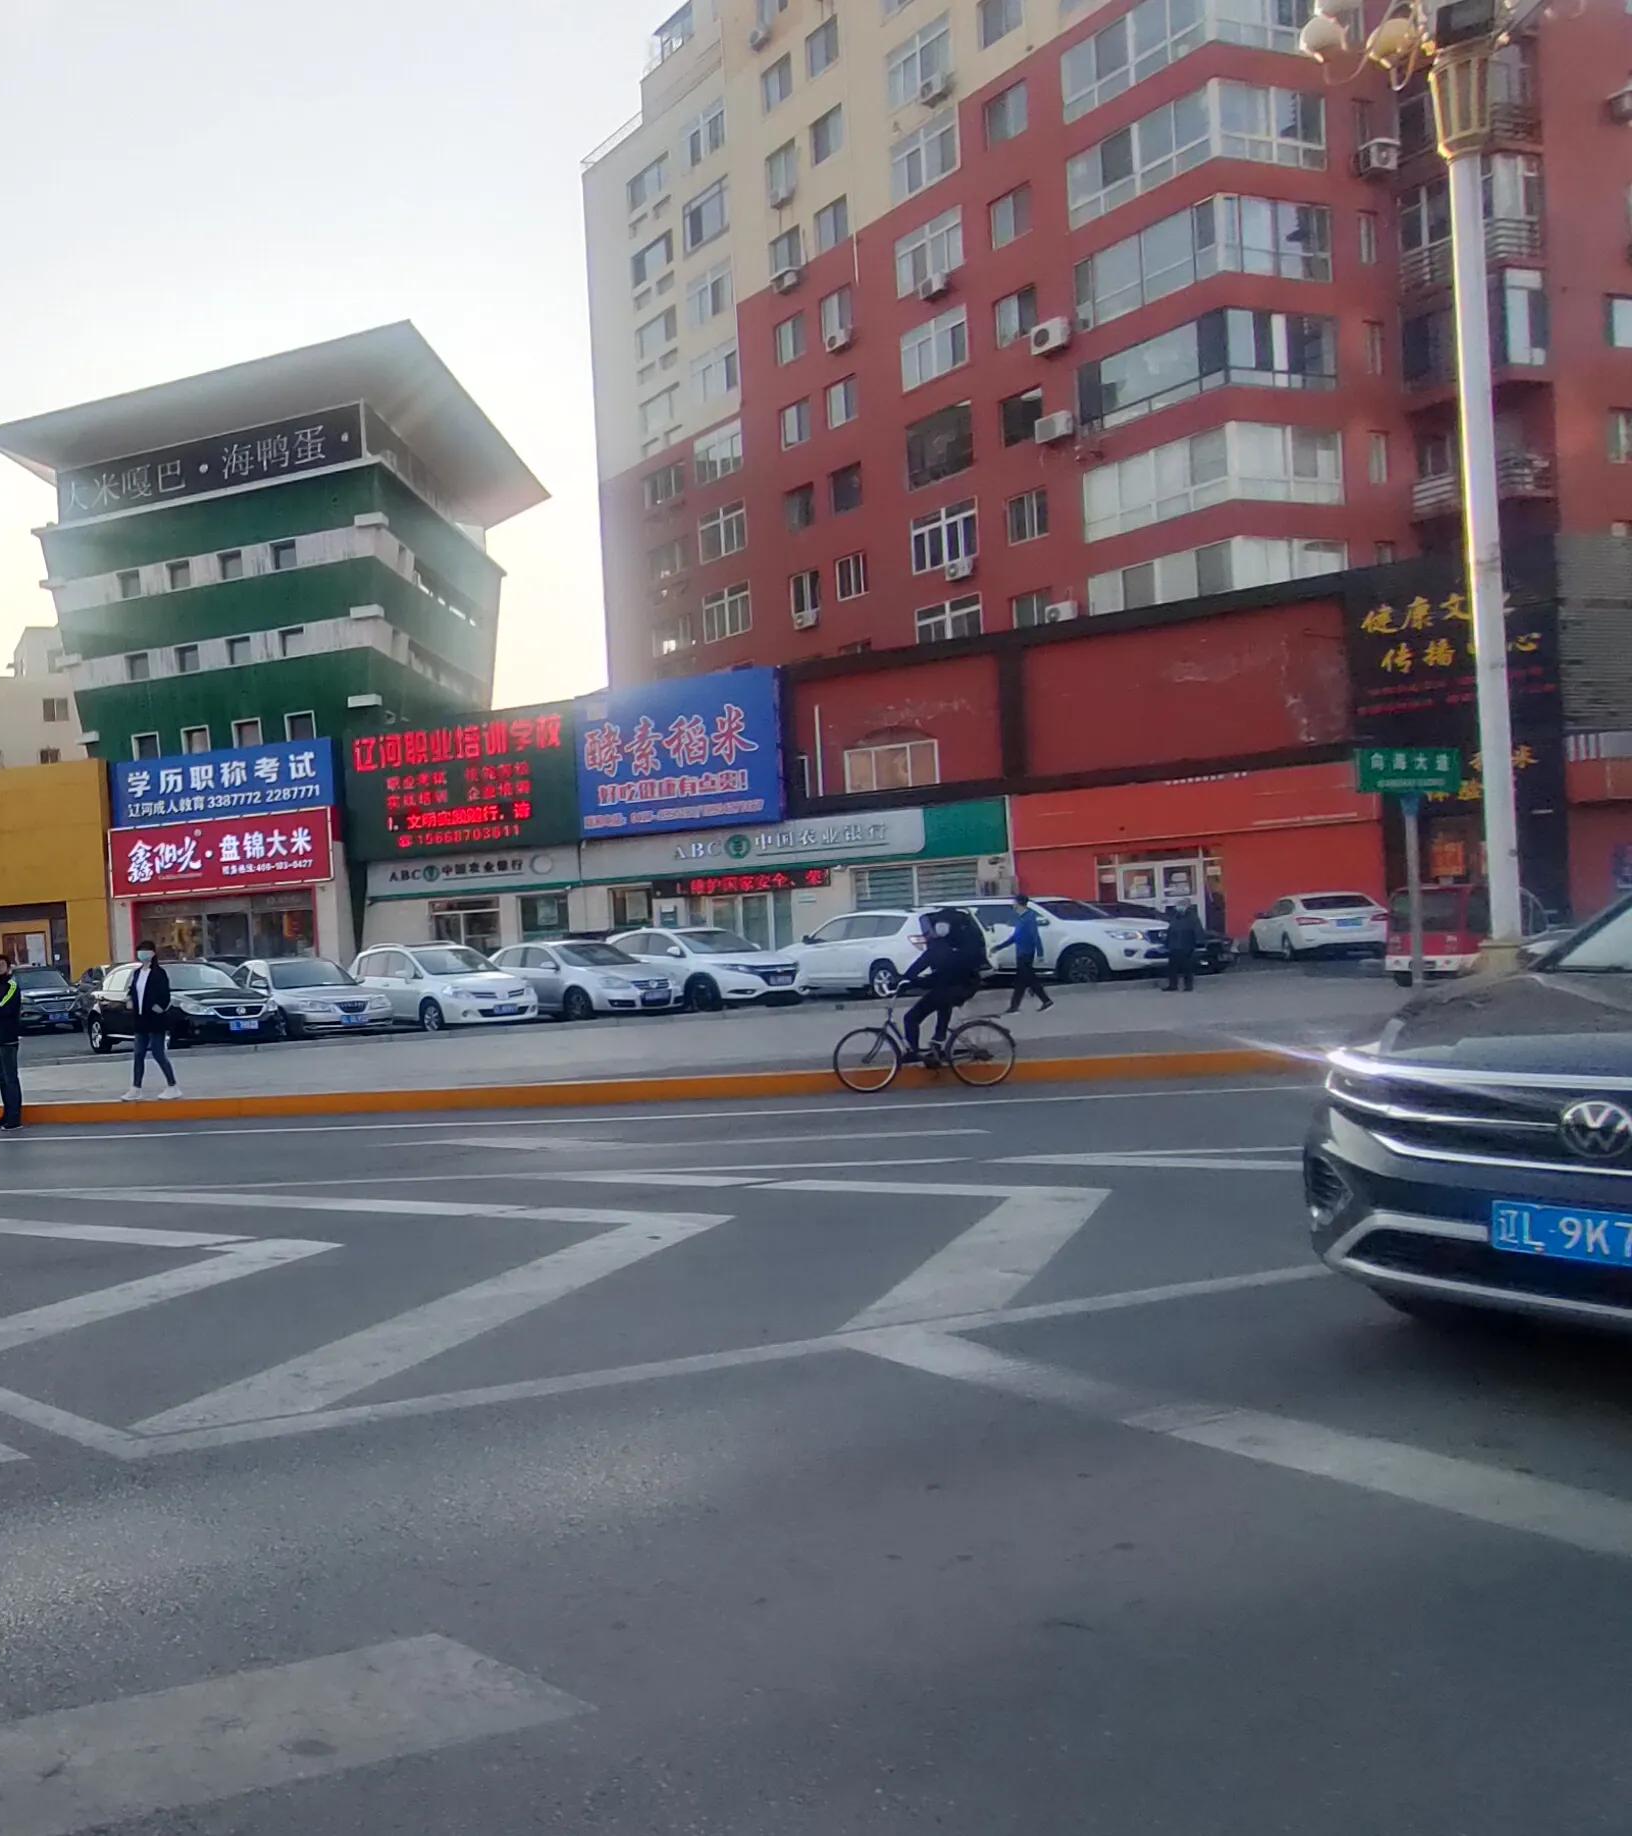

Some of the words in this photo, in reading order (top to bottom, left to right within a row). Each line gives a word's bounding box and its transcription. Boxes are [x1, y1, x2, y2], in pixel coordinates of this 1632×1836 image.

[1380, 633, 1542, 673] 传播心
[353, 714, 562, 773] 辽河职业培训学校
[584, 703, 759, 777] 酵素稻米
[127, 751, 317, 798] 学历职称考试
[207, 791, 261, 809] 3387772
[266, 784, 320, 802] 2287771
[219, 827, 312, 862] 盘锦大米
[674, 841, 721, 861] ABC
[754, 822, 887, 851] 中国农业银行
[389, 868, 421, 882] ABC
[442, 858, 523, 875] 中国农业银行
